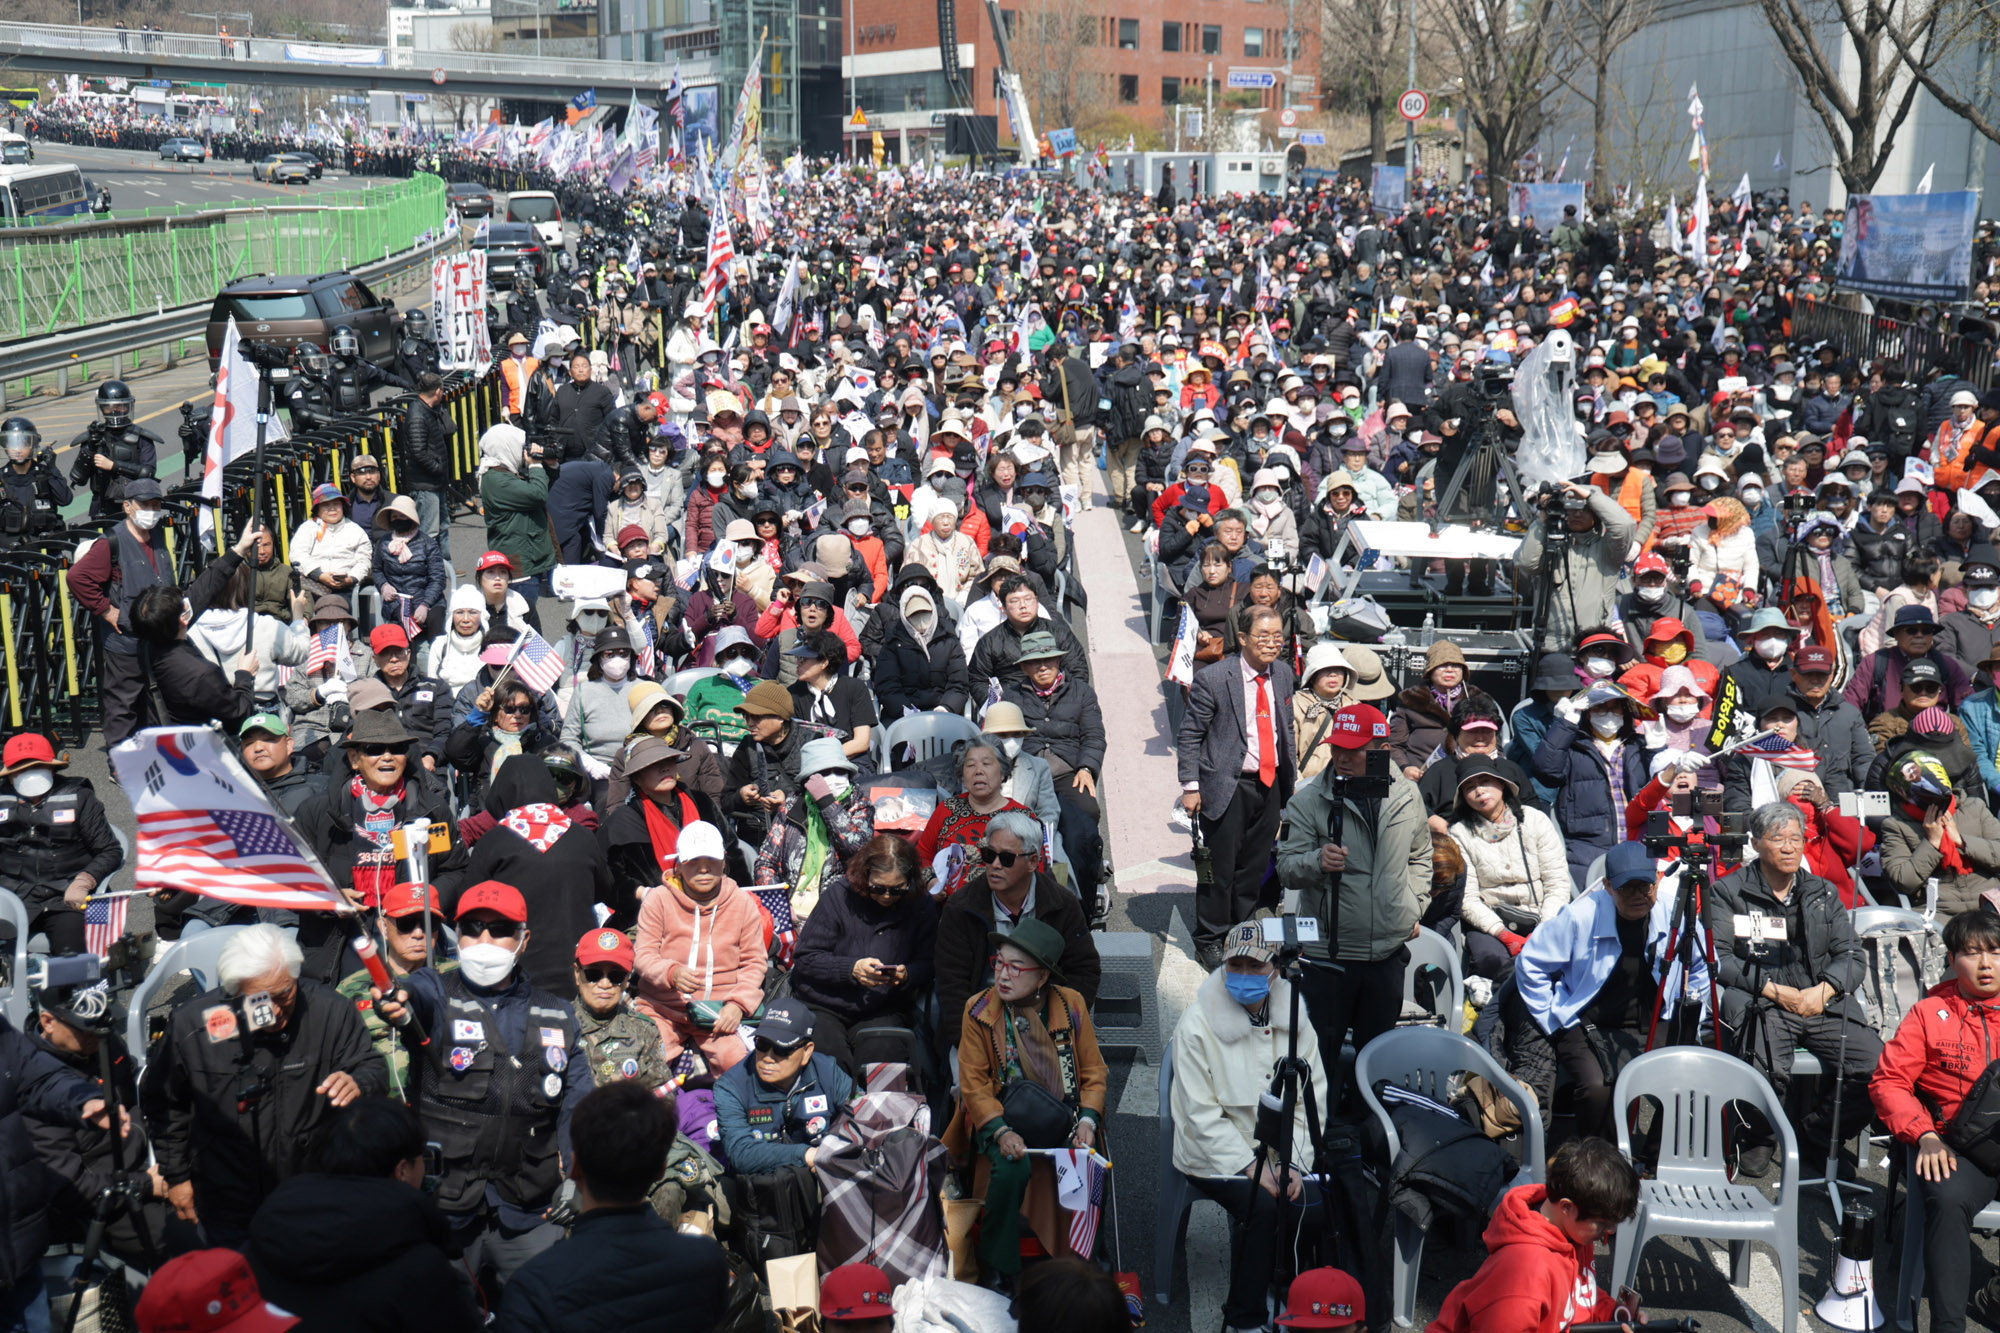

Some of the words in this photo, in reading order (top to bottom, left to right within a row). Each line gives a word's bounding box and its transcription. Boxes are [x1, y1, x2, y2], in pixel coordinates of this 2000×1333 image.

[1405, 98, 1422, 111] 60
[1711, 675, 1735, 747] 돌아와요!
[1342, 722, 1361, 732] 반대!
[254, 1005, 270, 1017] 부정
[256, 1014, 272, 1025] 선거
[1935, 1041, 1976, 1052] RAIFFESEN
